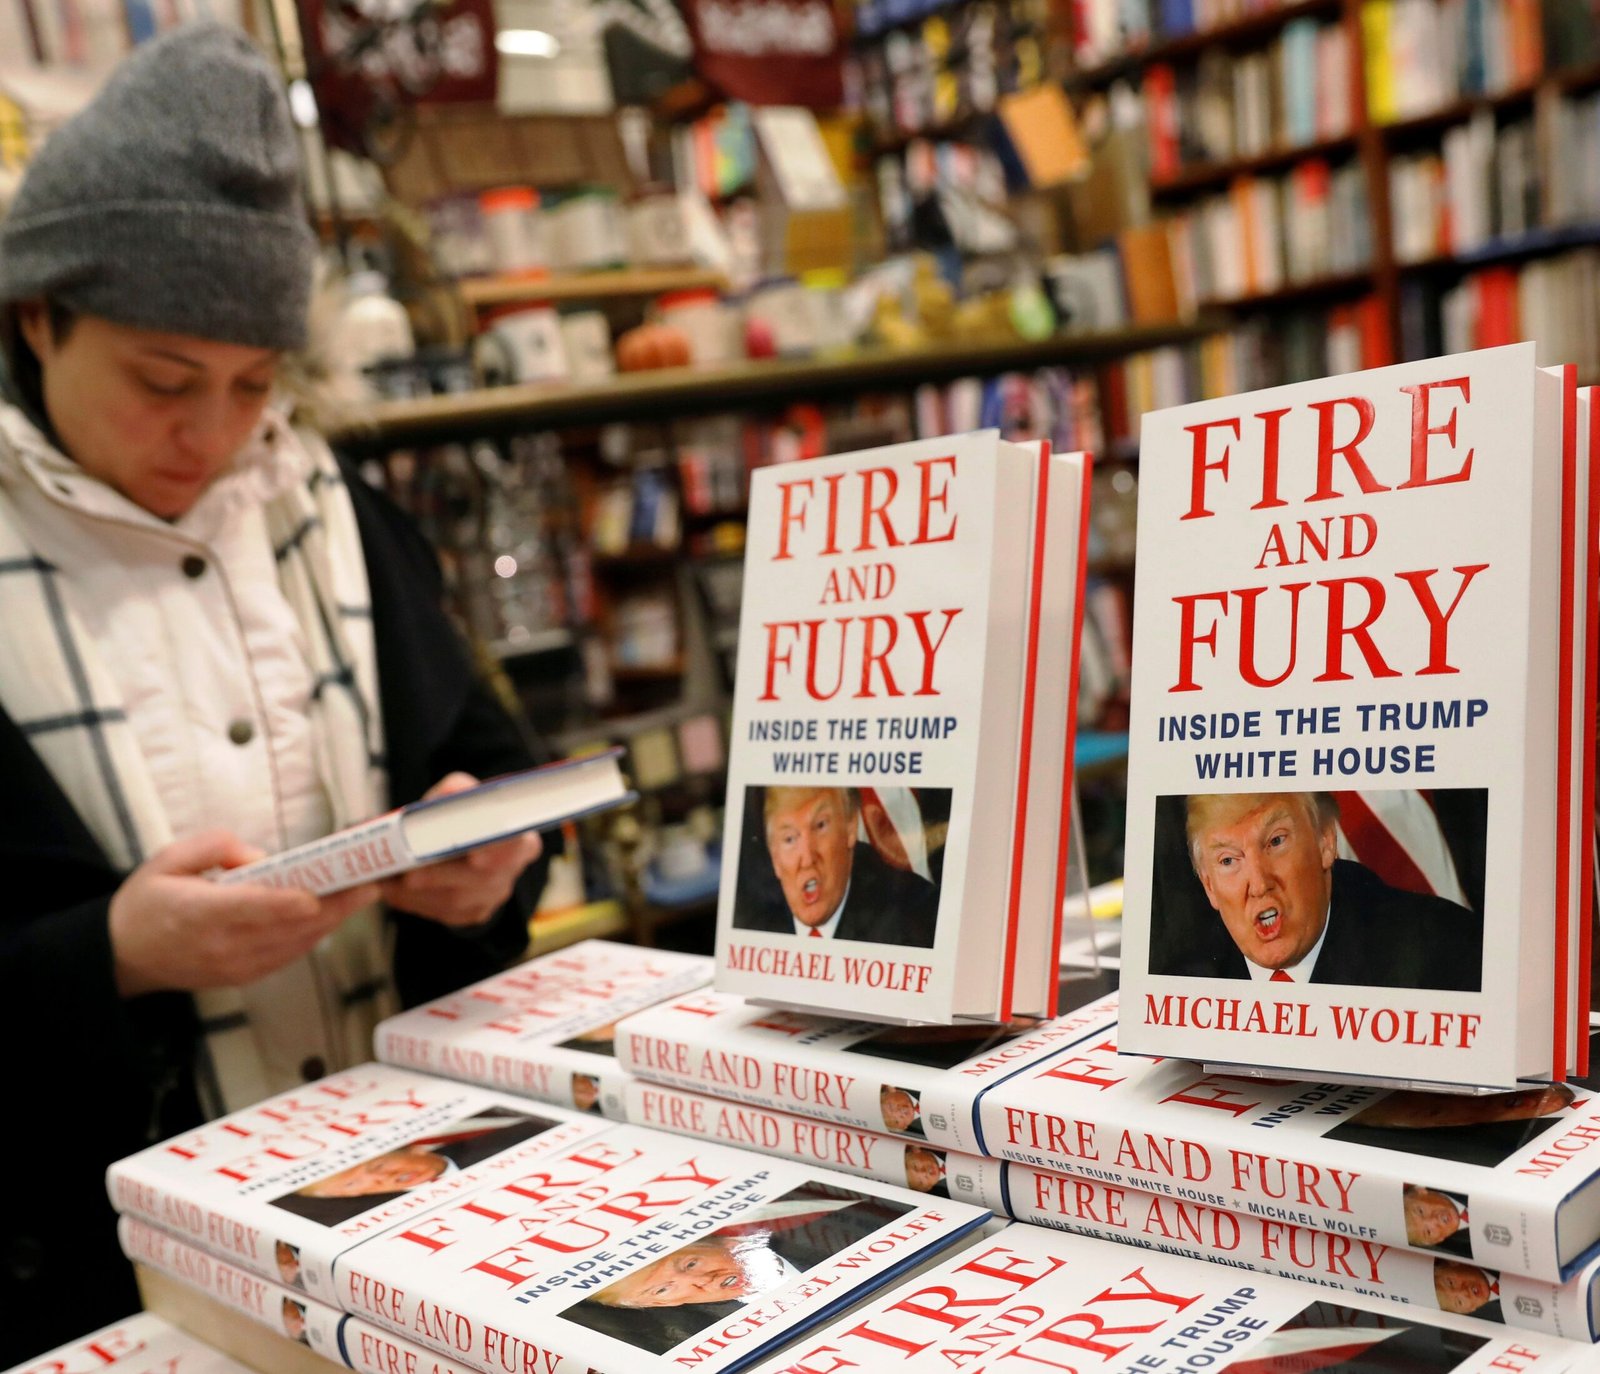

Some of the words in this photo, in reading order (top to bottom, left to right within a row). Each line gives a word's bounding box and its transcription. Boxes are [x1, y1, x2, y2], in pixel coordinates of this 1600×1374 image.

[1180, 376, 1475, 521] FIRE
[771, 454, 959, 561] FIRE
[1254, 512, 1378, 569] AND
[819, 562, 896, 605] AND
[756, 608, 963, 702] FURY
[1168, 563, 1490, 693] FURY
[748, 719, 818, 742] INSIDE
[828, 718, 868, 741] THE
[876, 716, 958, 741] TRUMP
[1158, 711, 1261, 742] INSIDE
[1275, 706, 1340, 735] THE
[1356, 699, 1489, 732] TRUMP
[772, 752, 840, 775] WHITE
[847, 752, 922, 775] HOUSE
[1195, 748, 1297, 780] WHITE
[1312, 744, 1435, 775] HOUSE
[726, 943, 836, 983] MICHAEL
[843, 957, 933, 995] WOLFF
[960, 1017, 1091, 1077] MICHAEL
[1144, 993, 1318, 1038] MICHAEL
[1329, 1005, 1482, 1050] WOLFF
[384, 1032, 437, 1066] FIRE
[439, 1045, 486, 1078] AND
[492, 1055, 554, 1095] FURY
[629, 1033, 692, 1075] FIRE
[700, 1049, 761, 1090] AND
[773, 1062, 855, 1111] FURY
[642, 1090, 707, 1134] FIRE
[716, 1107, 781, 1149] AND
[793, 1121, 878, 1170] FURY
[1251, 1083, 1342, 1129] INSIDE
[1315, 1086, 1384, 1116] WHI
[1004, 1106, 1100, 1161] FIRE
[1113, 1129, 1212, 1182] AND
[1228, 1149, 1361, 1214] FURY
[1514, 1116, 1600, 1179] MICH
[341, 1173, 482, 1237] MICHAEL
[386, 1141, 646, 1256] FIRE
[460, 1156, 731, 1290] FURY
[519, 1185, 609, 1231] AND
[1002, 1150, 1045, 1165] INSIDE
[1047, 1159, 1074, 1172] THE
[1077, 1165, 1123, 1182] TRUMP
[1127, 1176, 1172, 1195] WHITE
[1177, 1186, 1226, 1207] HOUSE
[1248, 1202, 1318, 1226] MICHAEL
[1323, 1217, 1378, 1239] WOLFF
[165, 1194, 202, 1235] AND
[207, 1211, 261, 1260] FURY
[514, 1250, 617, 1304] INSIDE
[619, 1220, 679, 1248] THE
[680, 1170, 770, 1217] TRUMP
[571, 1242, 670, 1291] WHITE
[672, 1191, 767, 1240] HOUSE
[836, 1209, 945, 1271] WOLFF
[1029, 1215, 1073, 1231] INSIDE
[1076, 1225, 1101, 1238] THE
[1106, 1232, 1152, 1249] TRUMP
[1157, 1243, 1201, 1260] WHITE
[1033, 1173, 1128, 1228] FIRE
[1142, 1197, 1241, 1251] AND
[1258, 1218, 1390, 1284] FURY
[173, 1236, 212, 1288] AND
[215, 1265, 268, 1316] FURY
[349, 1270, 406, 1326] FIRE
[414, 1299, 472, 1353] AND
[483, 1325, 564, 1374] FURY
[940, 1305, 1045, 1370] AND
[1160, 1287, 1257, 1348] TRUMP
[360, 1331, 417, 1374] FIRE
